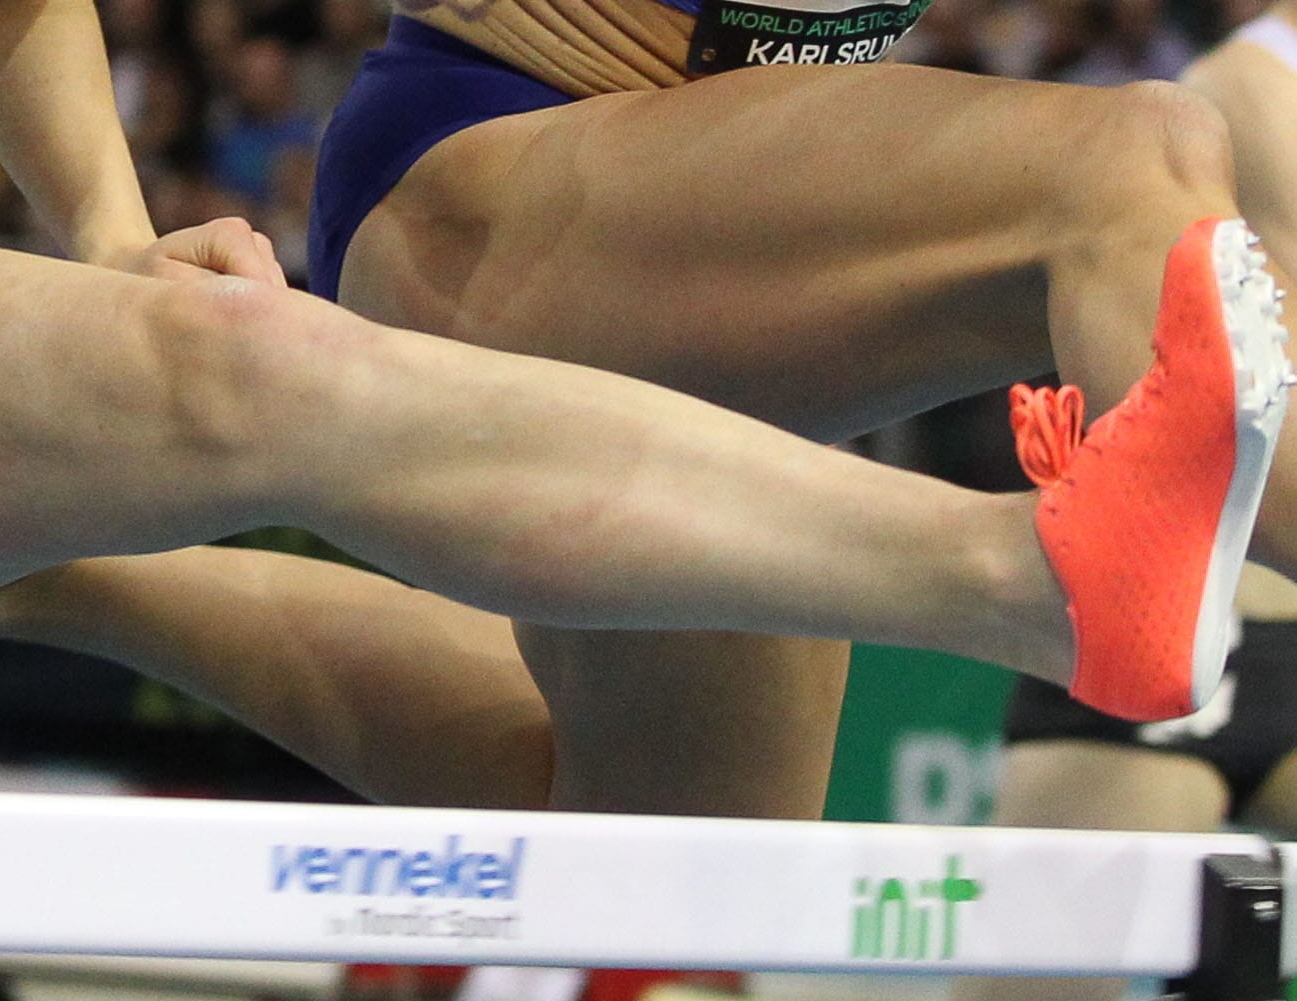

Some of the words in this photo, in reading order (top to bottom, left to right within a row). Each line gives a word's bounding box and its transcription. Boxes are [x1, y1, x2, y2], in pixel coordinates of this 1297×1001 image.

[720, 7, 804, 34] WORLD
[806, 11, 907, 38] ATHLETICS
[850, 853, 983, 962] init
